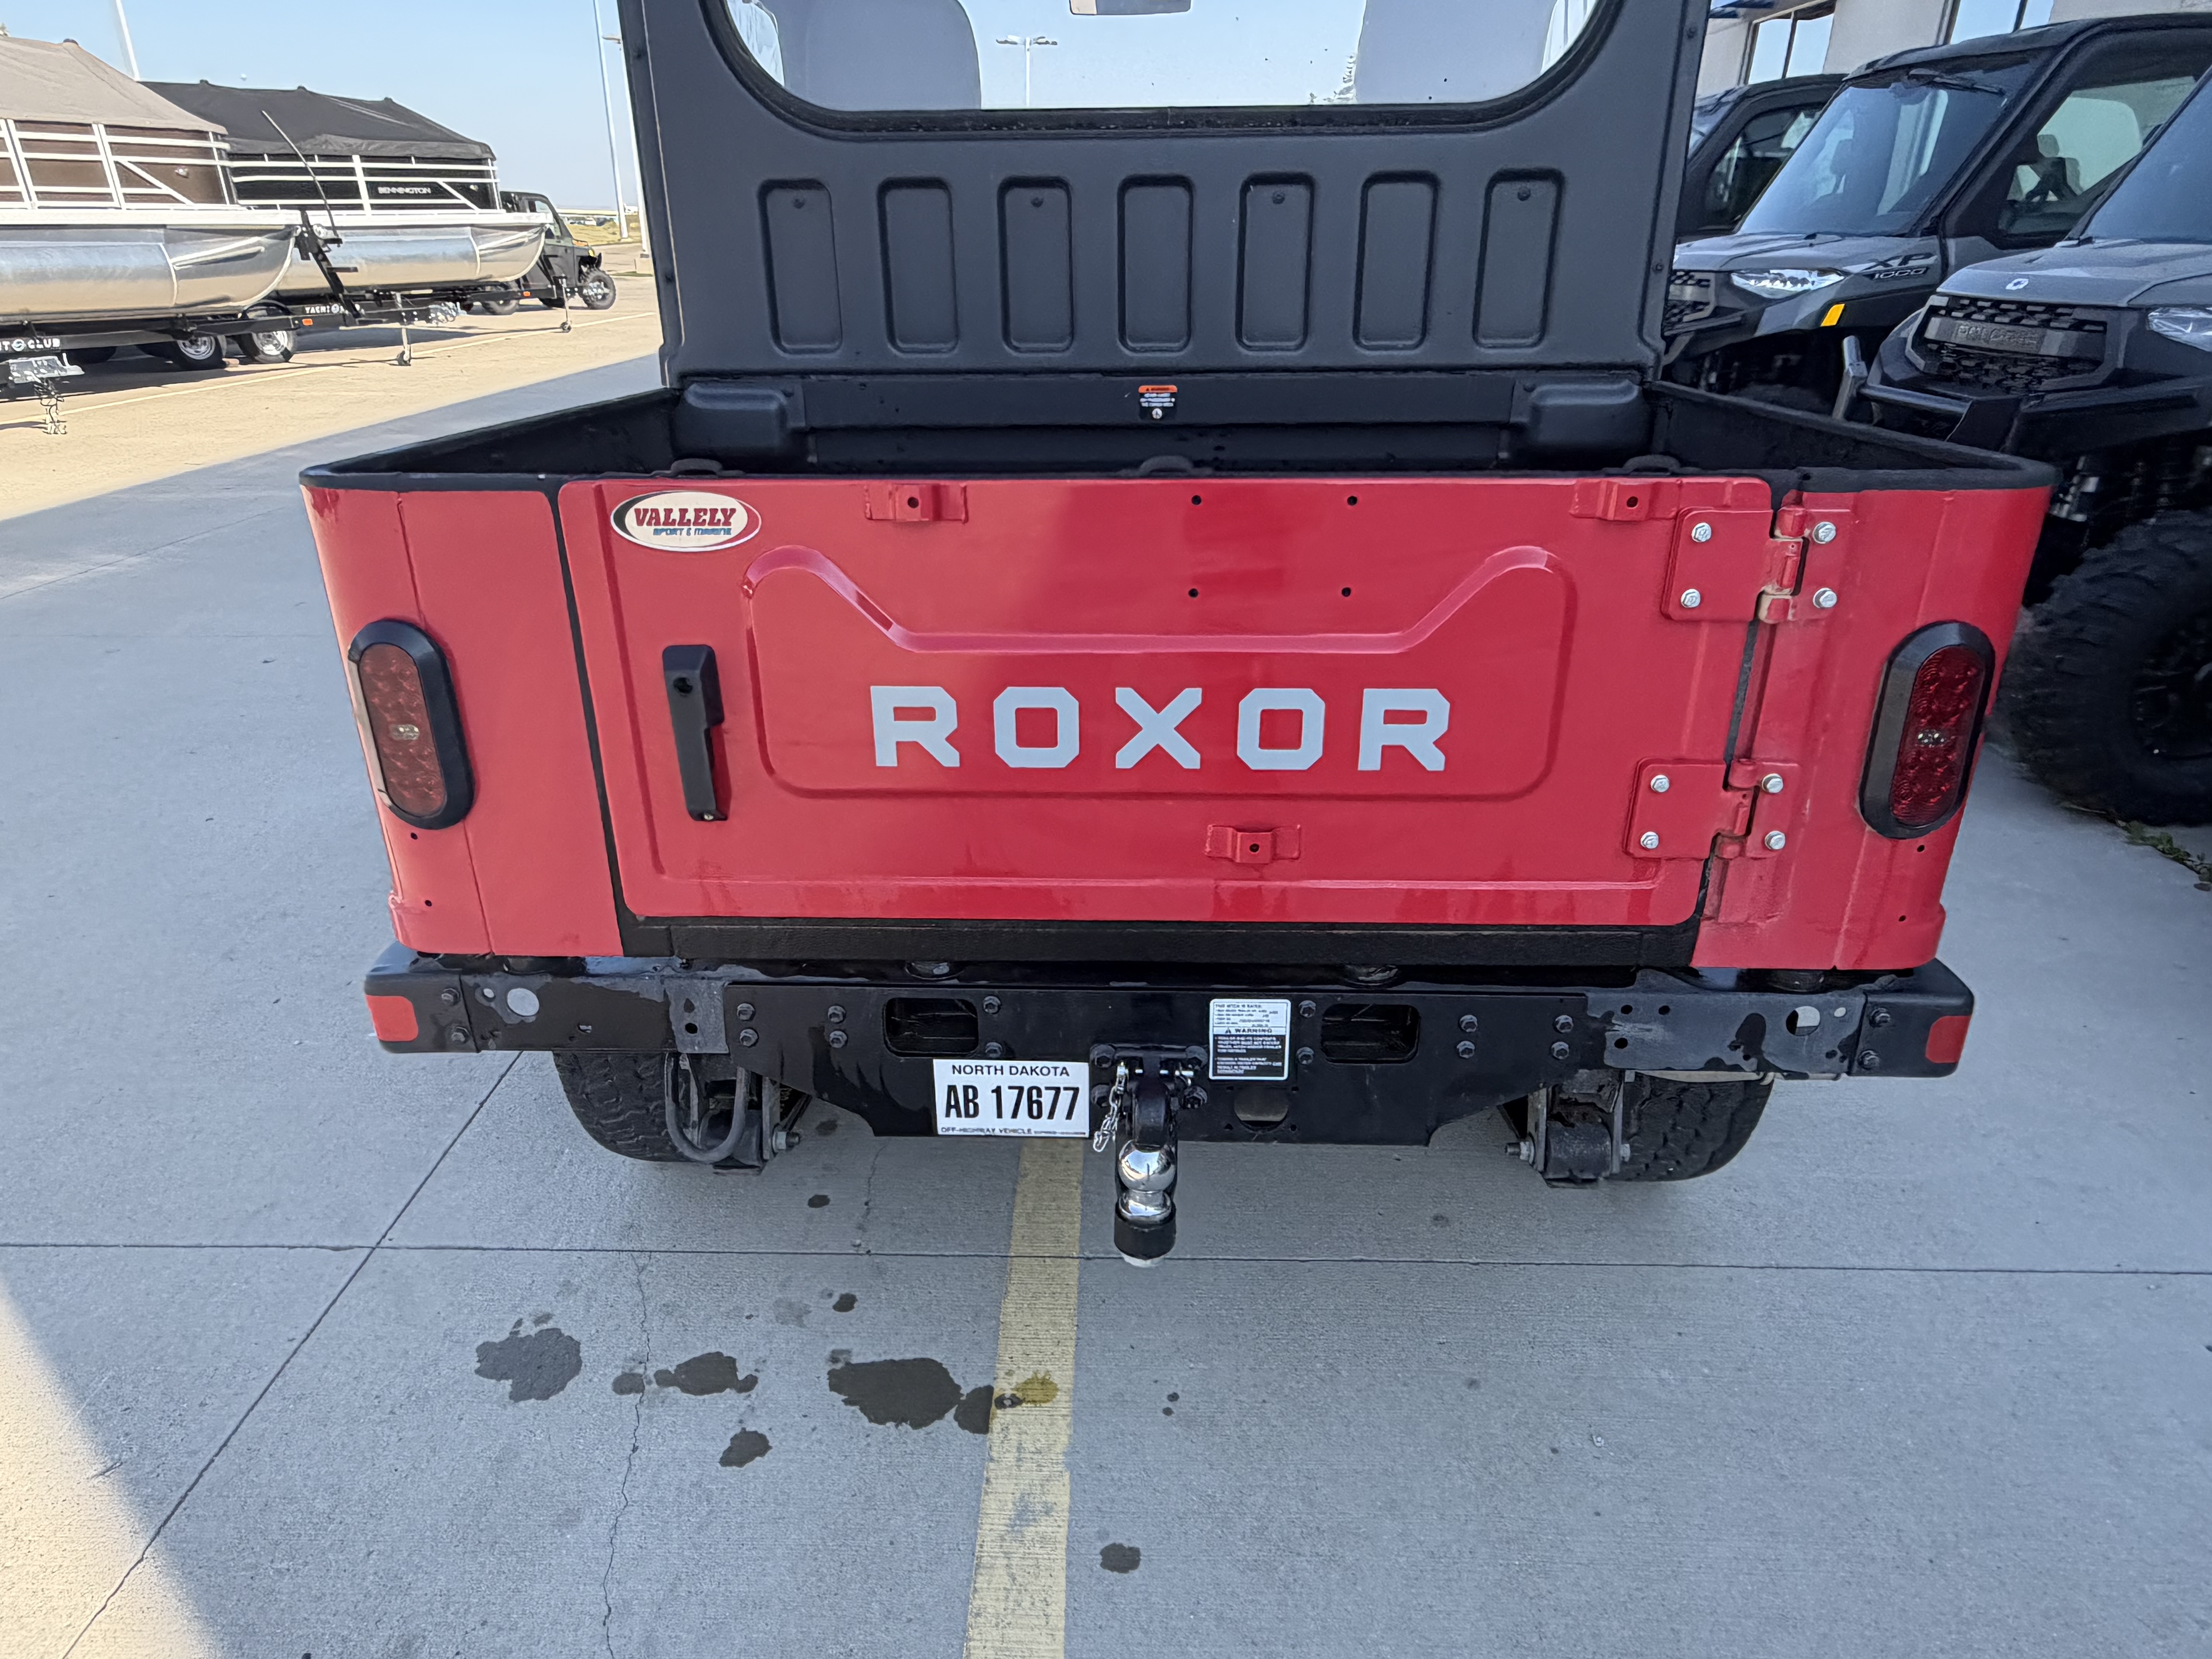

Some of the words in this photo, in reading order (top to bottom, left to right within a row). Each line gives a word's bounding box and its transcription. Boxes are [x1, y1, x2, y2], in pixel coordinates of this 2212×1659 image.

[1861, 252, 1934, 271] XP
[1874, 267, 1927, 280] 1000
[634, 508, 737, 526] VALLELY
[870, 685, 1450, 771] ROXOR
[952, 1065, 1004, 1075] NORTH
[1009, 1066, 1070, 1077] DAKOTA
[945, 1084, 979, 1118] AB
[991, 1085, 1080, 1120] 17677
